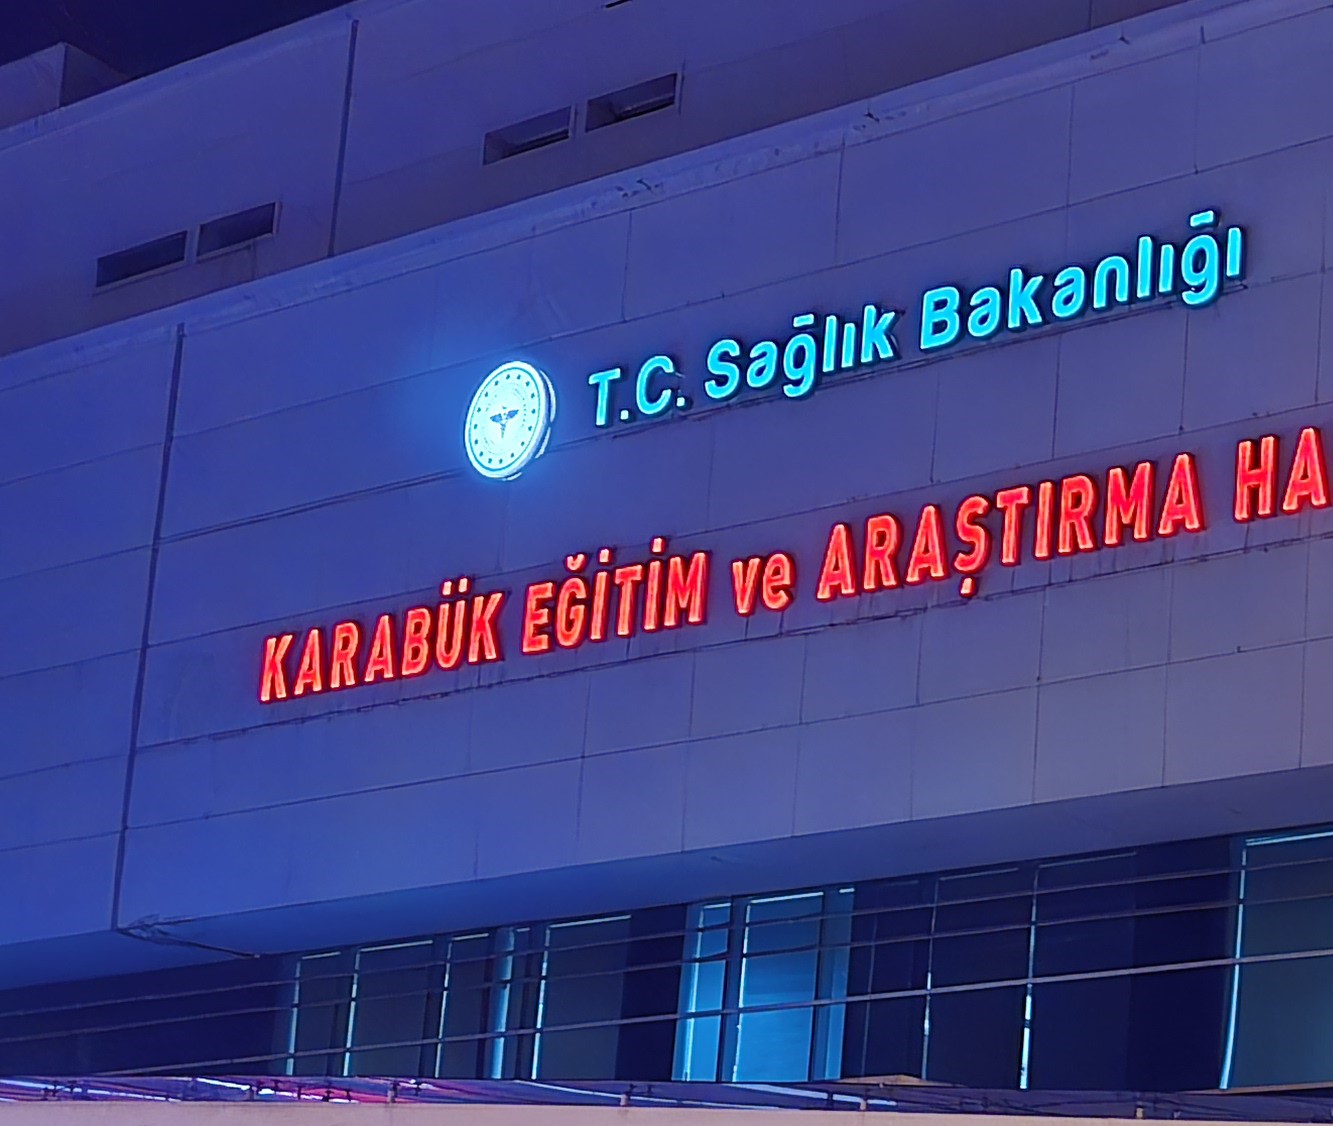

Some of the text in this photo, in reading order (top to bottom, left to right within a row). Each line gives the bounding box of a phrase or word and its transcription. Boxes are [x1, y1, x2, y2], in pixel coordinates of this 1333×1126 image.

[588, 210, 1243, 426] T.C. Sağlık Bakanlığı
[258, 577, 504, 702] KARABÜK
[521, 537, 708, 656] EĞİTİM
[731, 551, 792, 616] ve
[816, 453, 1202, 600] ARAŞTIRMA
